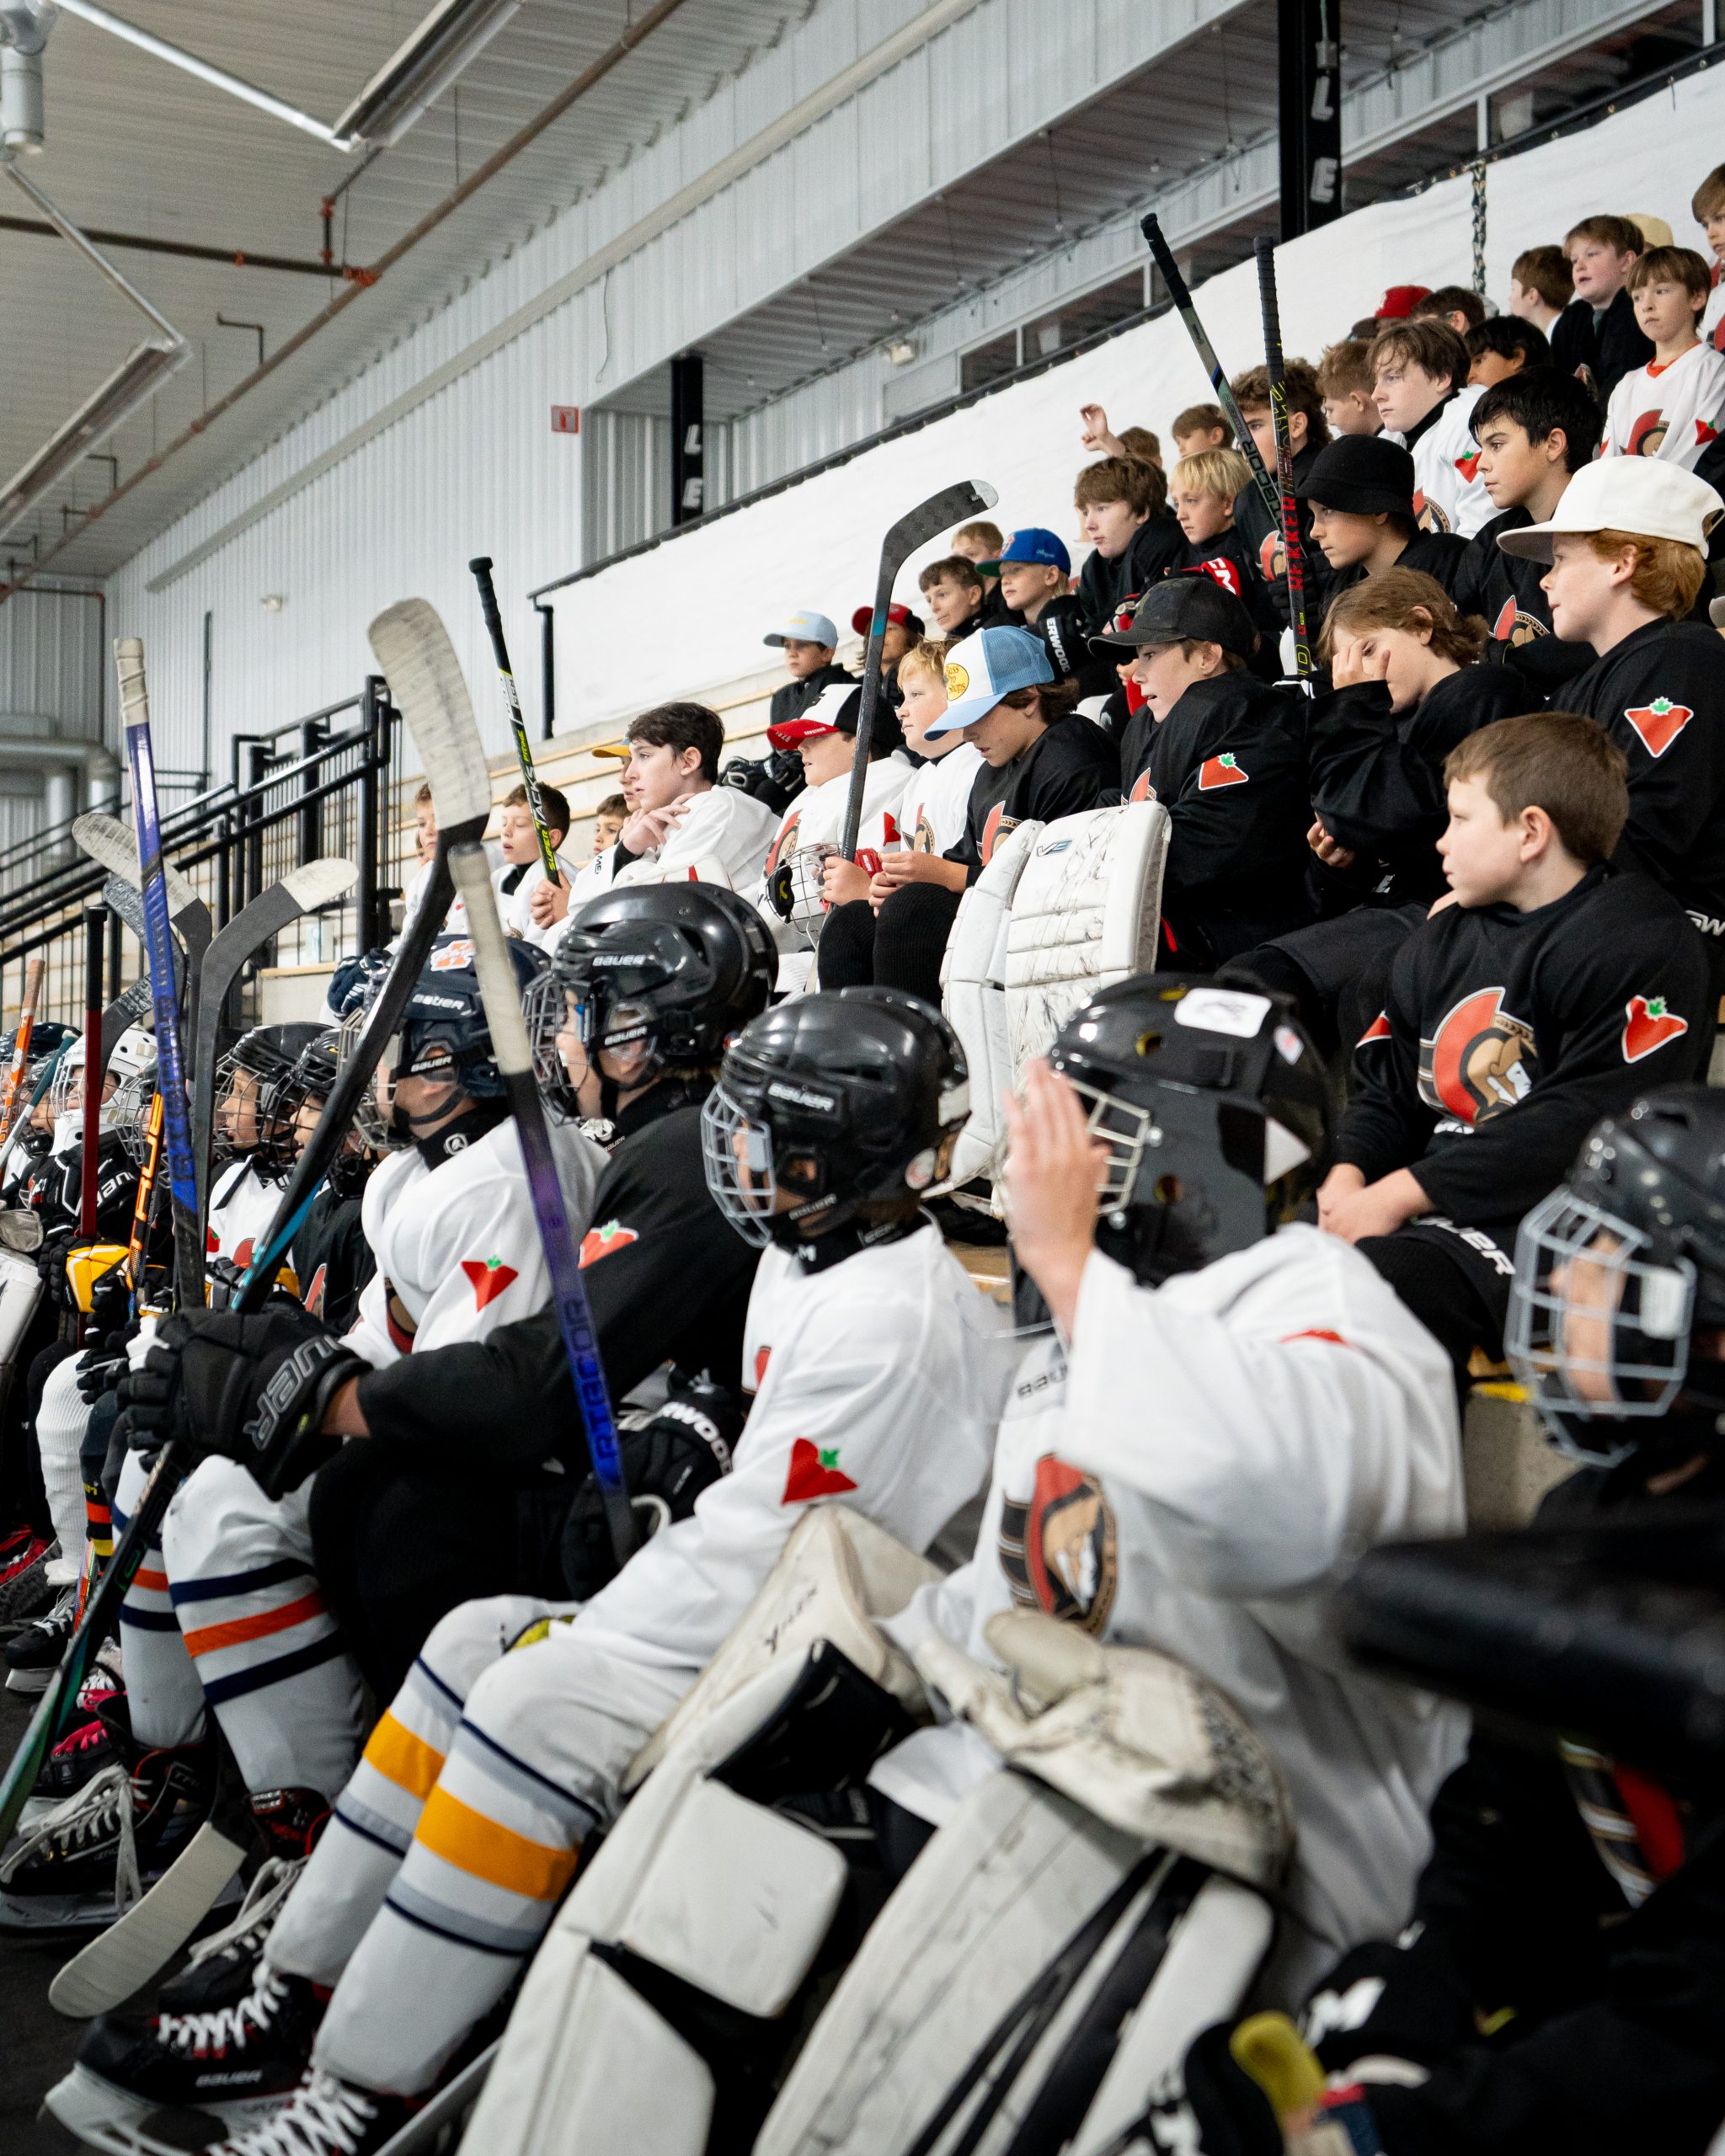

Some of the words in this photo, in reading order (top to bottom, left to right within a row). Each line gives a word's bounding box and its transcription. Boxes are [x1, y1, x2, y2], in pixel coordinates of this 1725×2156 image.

[1280, 496, 1304, 590] REKKER
[508, 677, 520, 707] CCM
[516, 729, 530, 762] PRIME
[524, 765, 548, 827] TACKS
[542, 830, 556, 871] SUPER
[591, 954, 647, 968] BAUER
[411, 993, 464, 1011] BAUER
[604, 1025, 649, 1047] BAUER
[410, 1054, 453, 1073] BAUER
[131, 1092, 163, 1251] TRUE
